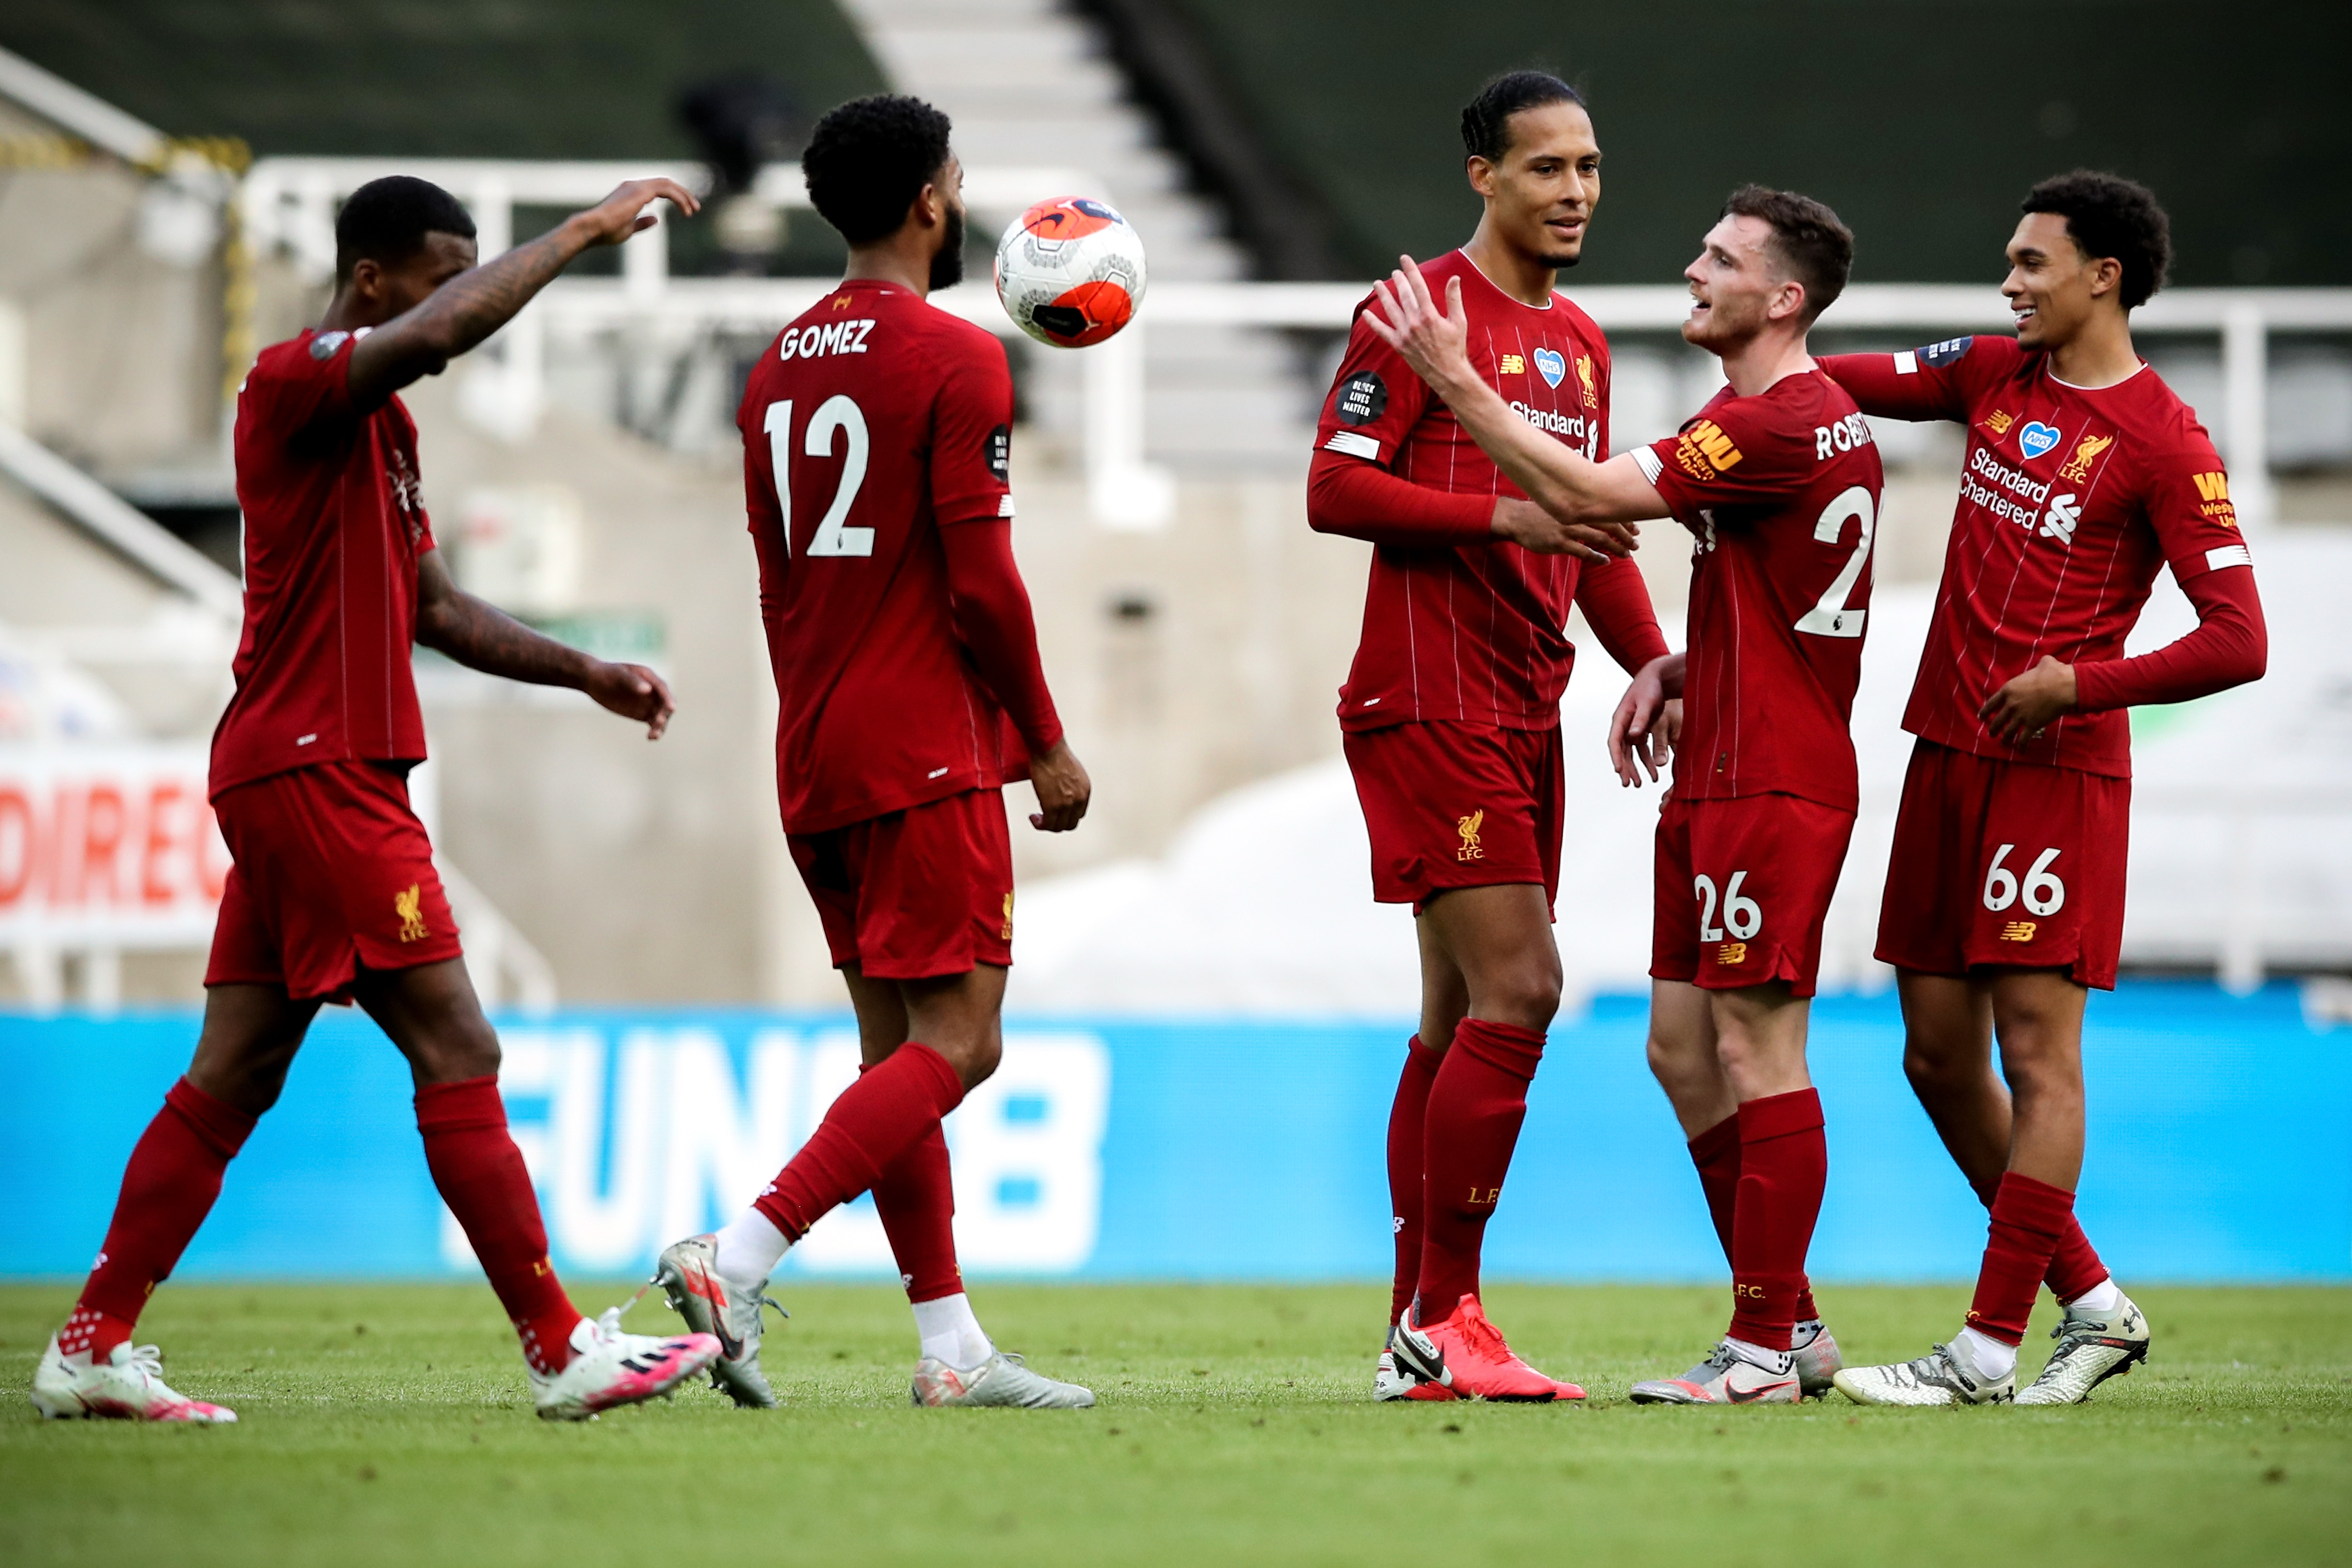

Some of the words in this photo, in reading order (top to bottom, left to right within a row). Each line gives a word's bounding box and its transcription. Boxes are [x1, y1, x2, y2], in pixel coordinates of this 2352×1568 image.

[779, 319, 876, 361] GOMEZ
[1542, 361, 1558, 373] NHS
[1342, 401, 1370, 417] MATTER
[1349, 391, 1370, 404] LIVES
[1509, 400, 1585, 438] Standard
[1678, 433, 1716, 480] Western
[1690, 419, 1744, 471] WU
[2027, 432, 2051, 448] NHS
[763, 394, 875, 560] 12
[1970, 447, 2051, 504] Standard
[1960, 472, 2039, 530] Chartered
[1982, 844, 2066, 917] 66
[1693, 870, 1762, 942] 26
